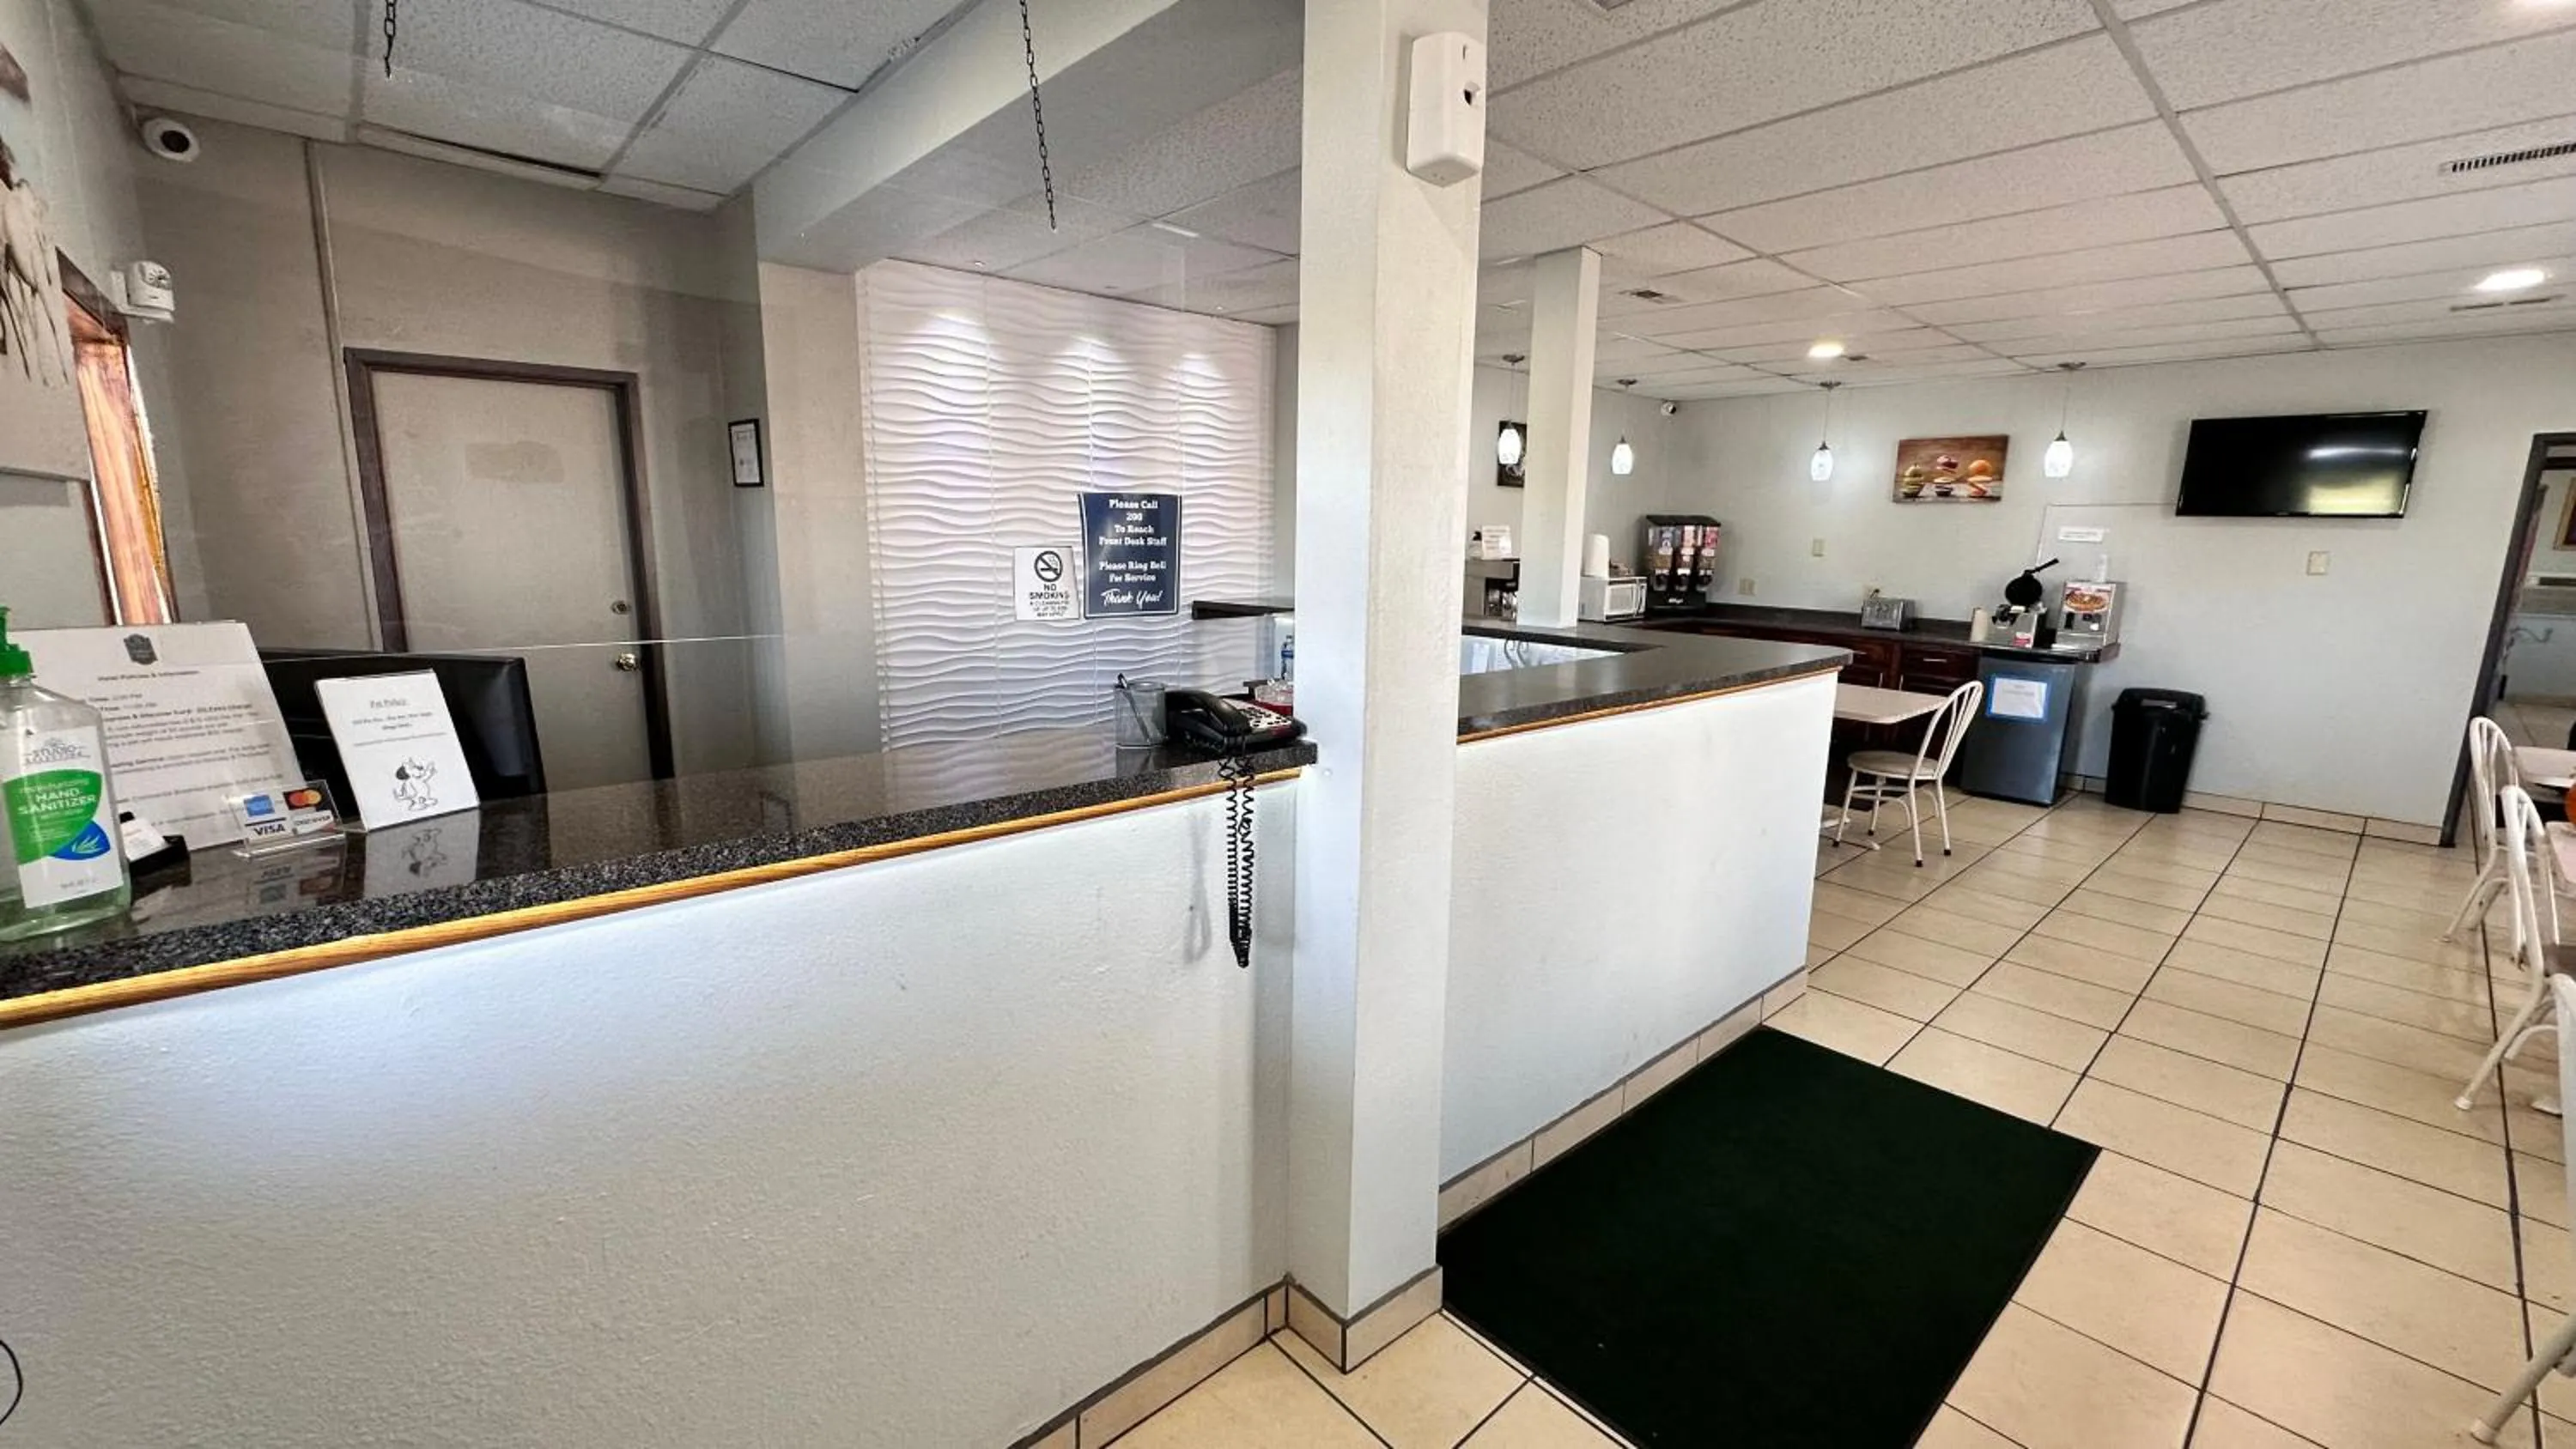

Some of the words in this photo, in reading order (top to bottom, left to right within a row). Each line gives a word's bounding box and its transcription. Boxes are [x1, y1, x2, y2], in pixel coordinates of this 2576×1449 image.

[1109, 499, 1139, 508] Please
[1115, 524, 1126, 533] To
[1127, 524, 1155, 533] Reach
[1099, 537, 1122, 545] Front
[1124, 537, 1145, 545] Desk
[1146, 537, 1167, 546] Staff
[1099, 561, 1127, 570] Please
[1127, 561, 1148, 571] Ring
[1150, 561, 1166, 569] Bell
[1109, 573, 1122, 582] For
[1124, 573, 1157, 581] Service
[1030, 591, 1070, 600] SMOKING
[1100, 588, 1133, 606] Thank
[1136, 590, 1163, 609] You!
[35, 787, 81, 803] HAND
[17, 795, 97, 815] SANITIZER
[253, 823, 286, 835] VISA
